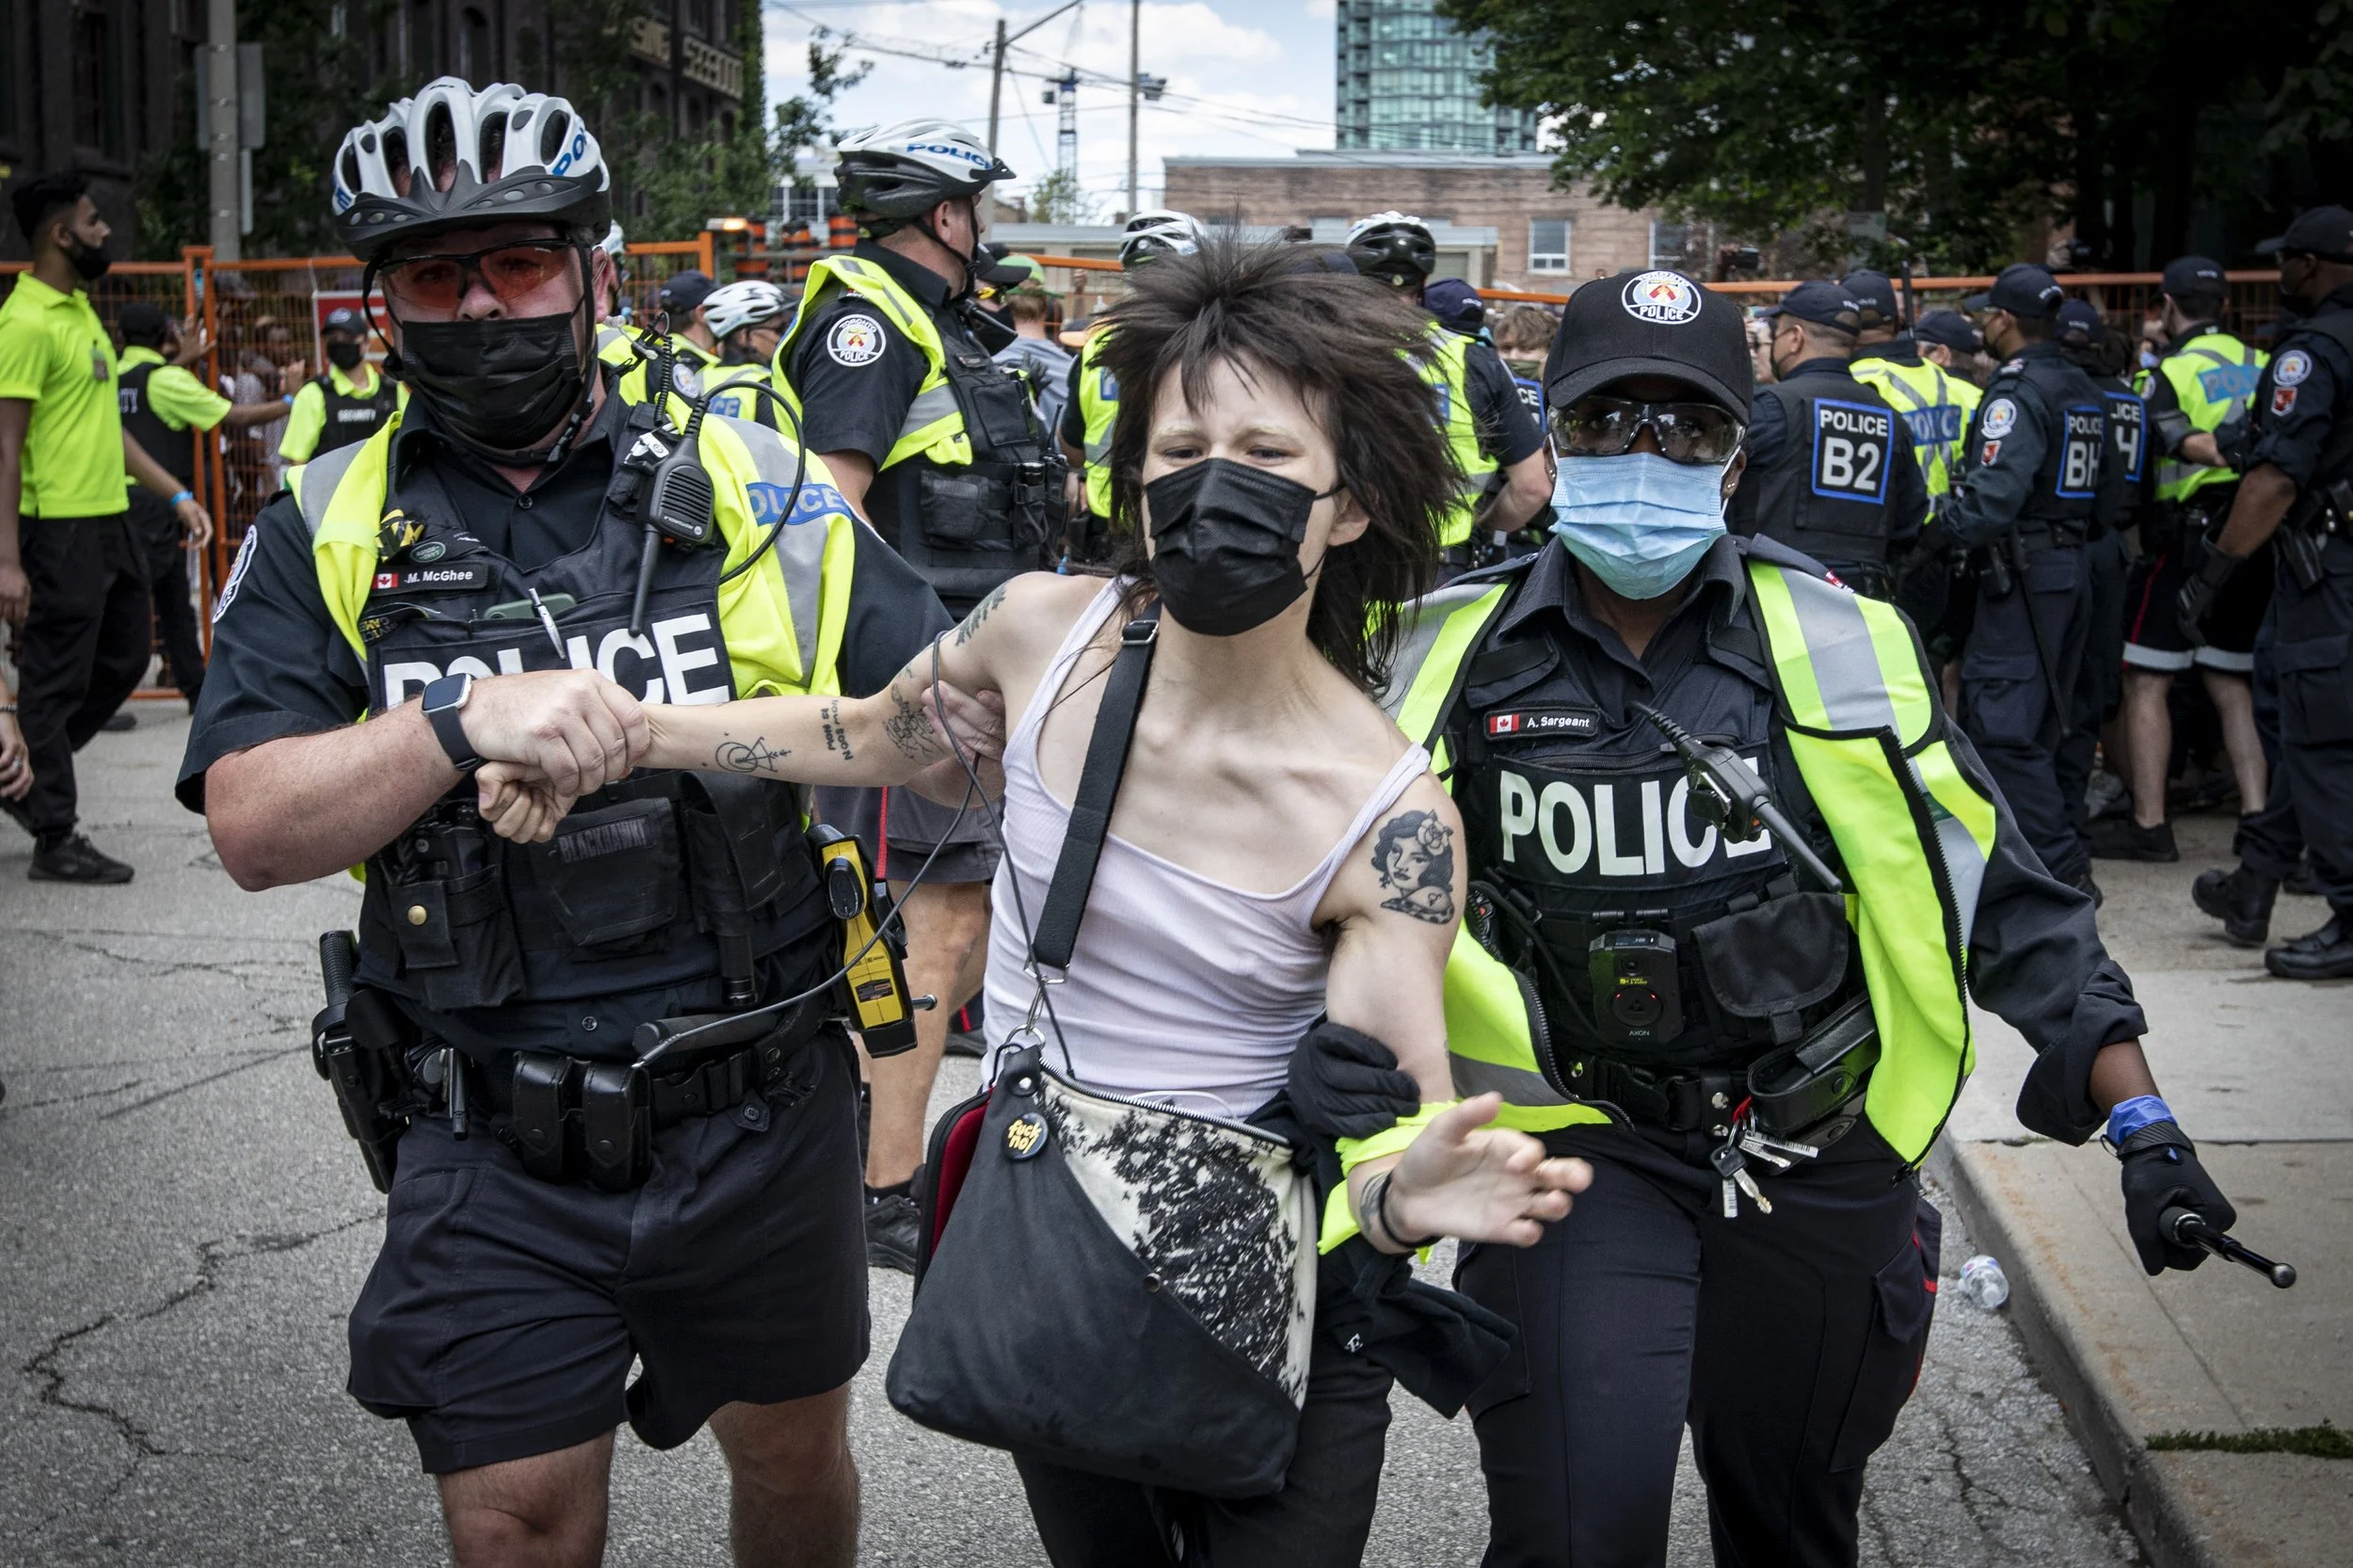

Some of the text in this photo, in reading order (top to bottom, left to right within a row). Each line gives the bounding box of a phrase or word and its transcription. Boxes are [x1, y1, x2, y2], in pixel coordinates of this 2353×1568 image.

[1640, 306, 1684, 321] POLICE
[839, 317, 877, 333] TORONTO
[840, 350, 870, 362] POLICE
[337, 408, 376, 423] SECURITY
[1819, 408, 1888, 437] POLICE
[1822, 436, 1881, 491] B2
[748, 487, 846, 519] OLICE
[405, 569, 474, 584] M. McGhee
[382, 612, 730, 712] PCE
[1526, 715, 1591, 729] A. Sargeant
[822, 724, 836, 750] NOW
[835, 728, 854, 760] SOON
